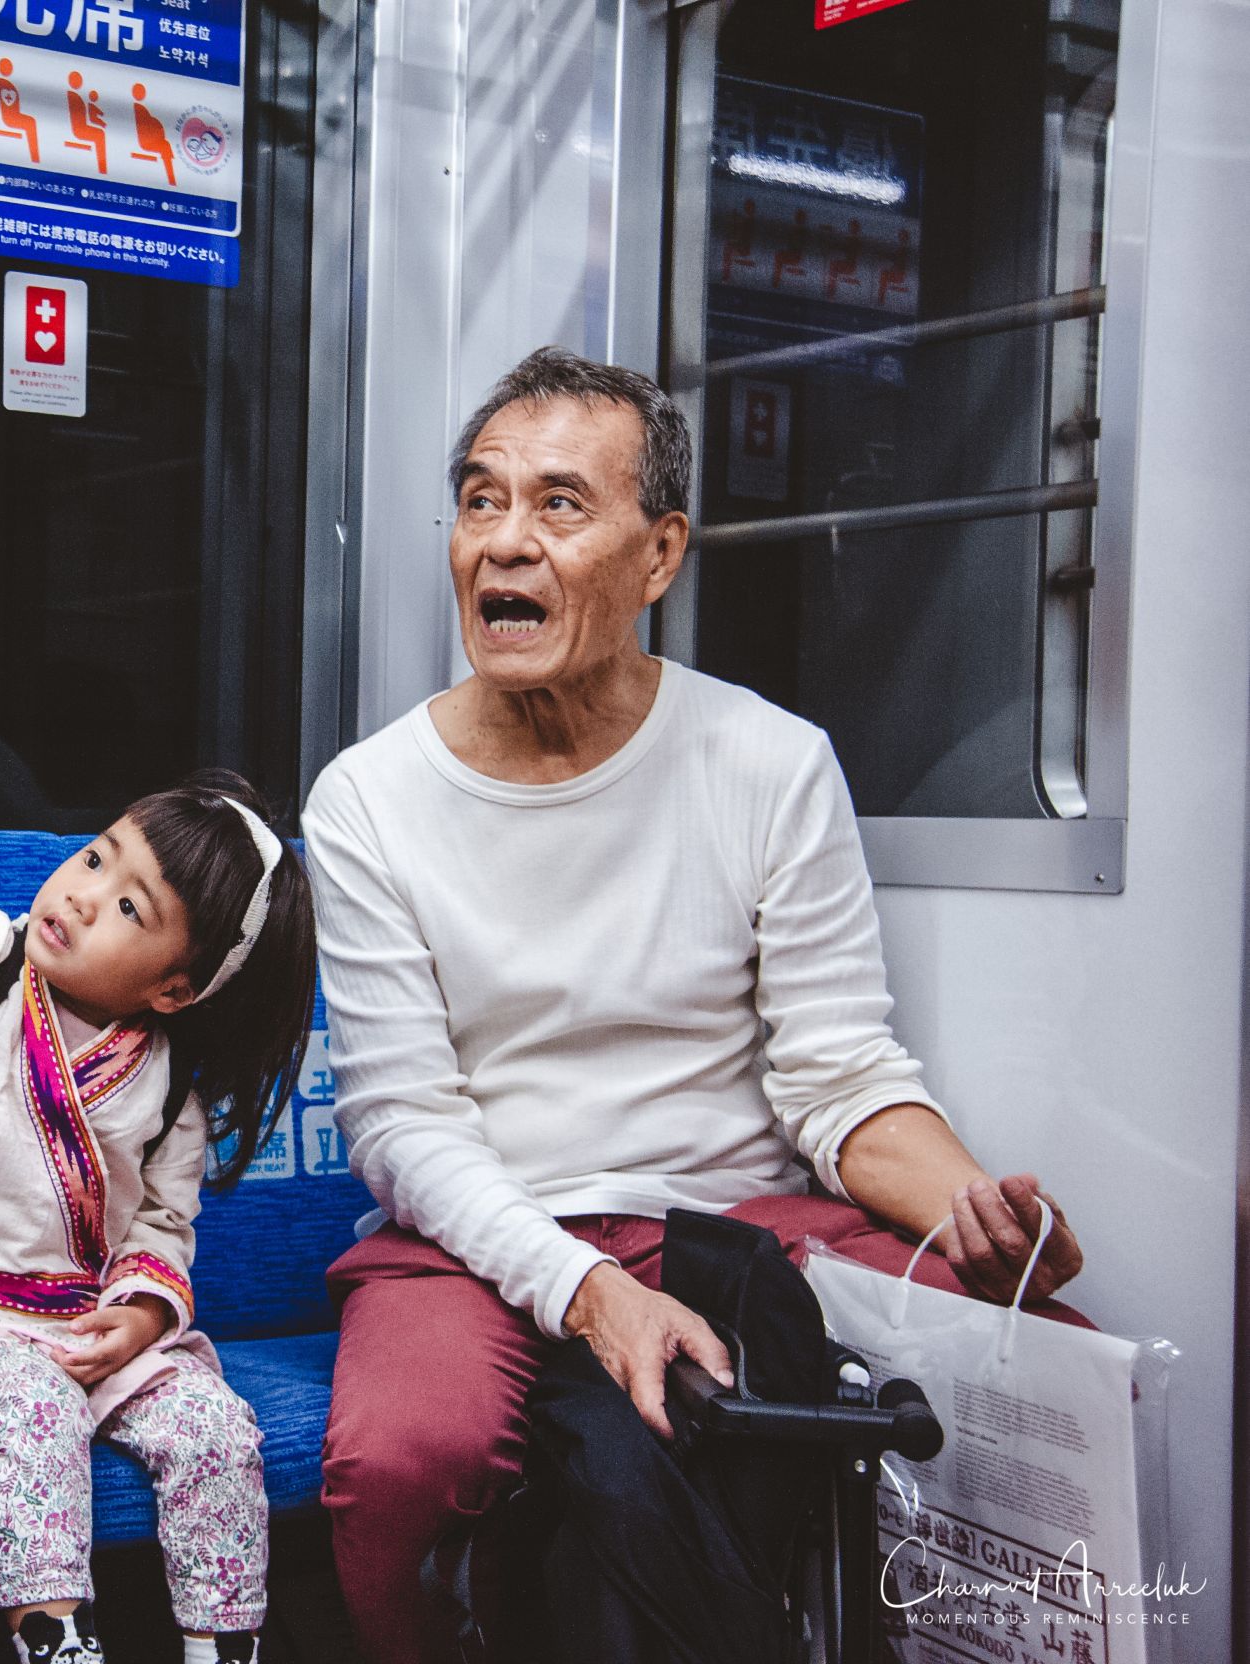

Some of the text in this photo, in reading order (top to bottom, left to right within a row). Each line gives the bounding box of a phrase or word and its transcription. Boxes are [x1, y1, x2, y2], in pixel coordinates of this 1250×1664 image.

[158, 17, 211, 41] 优先座位
[158, 45, 209, 68] 노약자석
[0, 234, 18, 245] turn
[20, 237, 32, 247] off
[34, 240, 53, 251] your
[55, 242, 83, 255] mobile
[85, 246, 111, 259] phone
[112, 250, 121, 260] in
[123, 251, 139, 263] this
[140, 254, 171, 268] vicinity.
